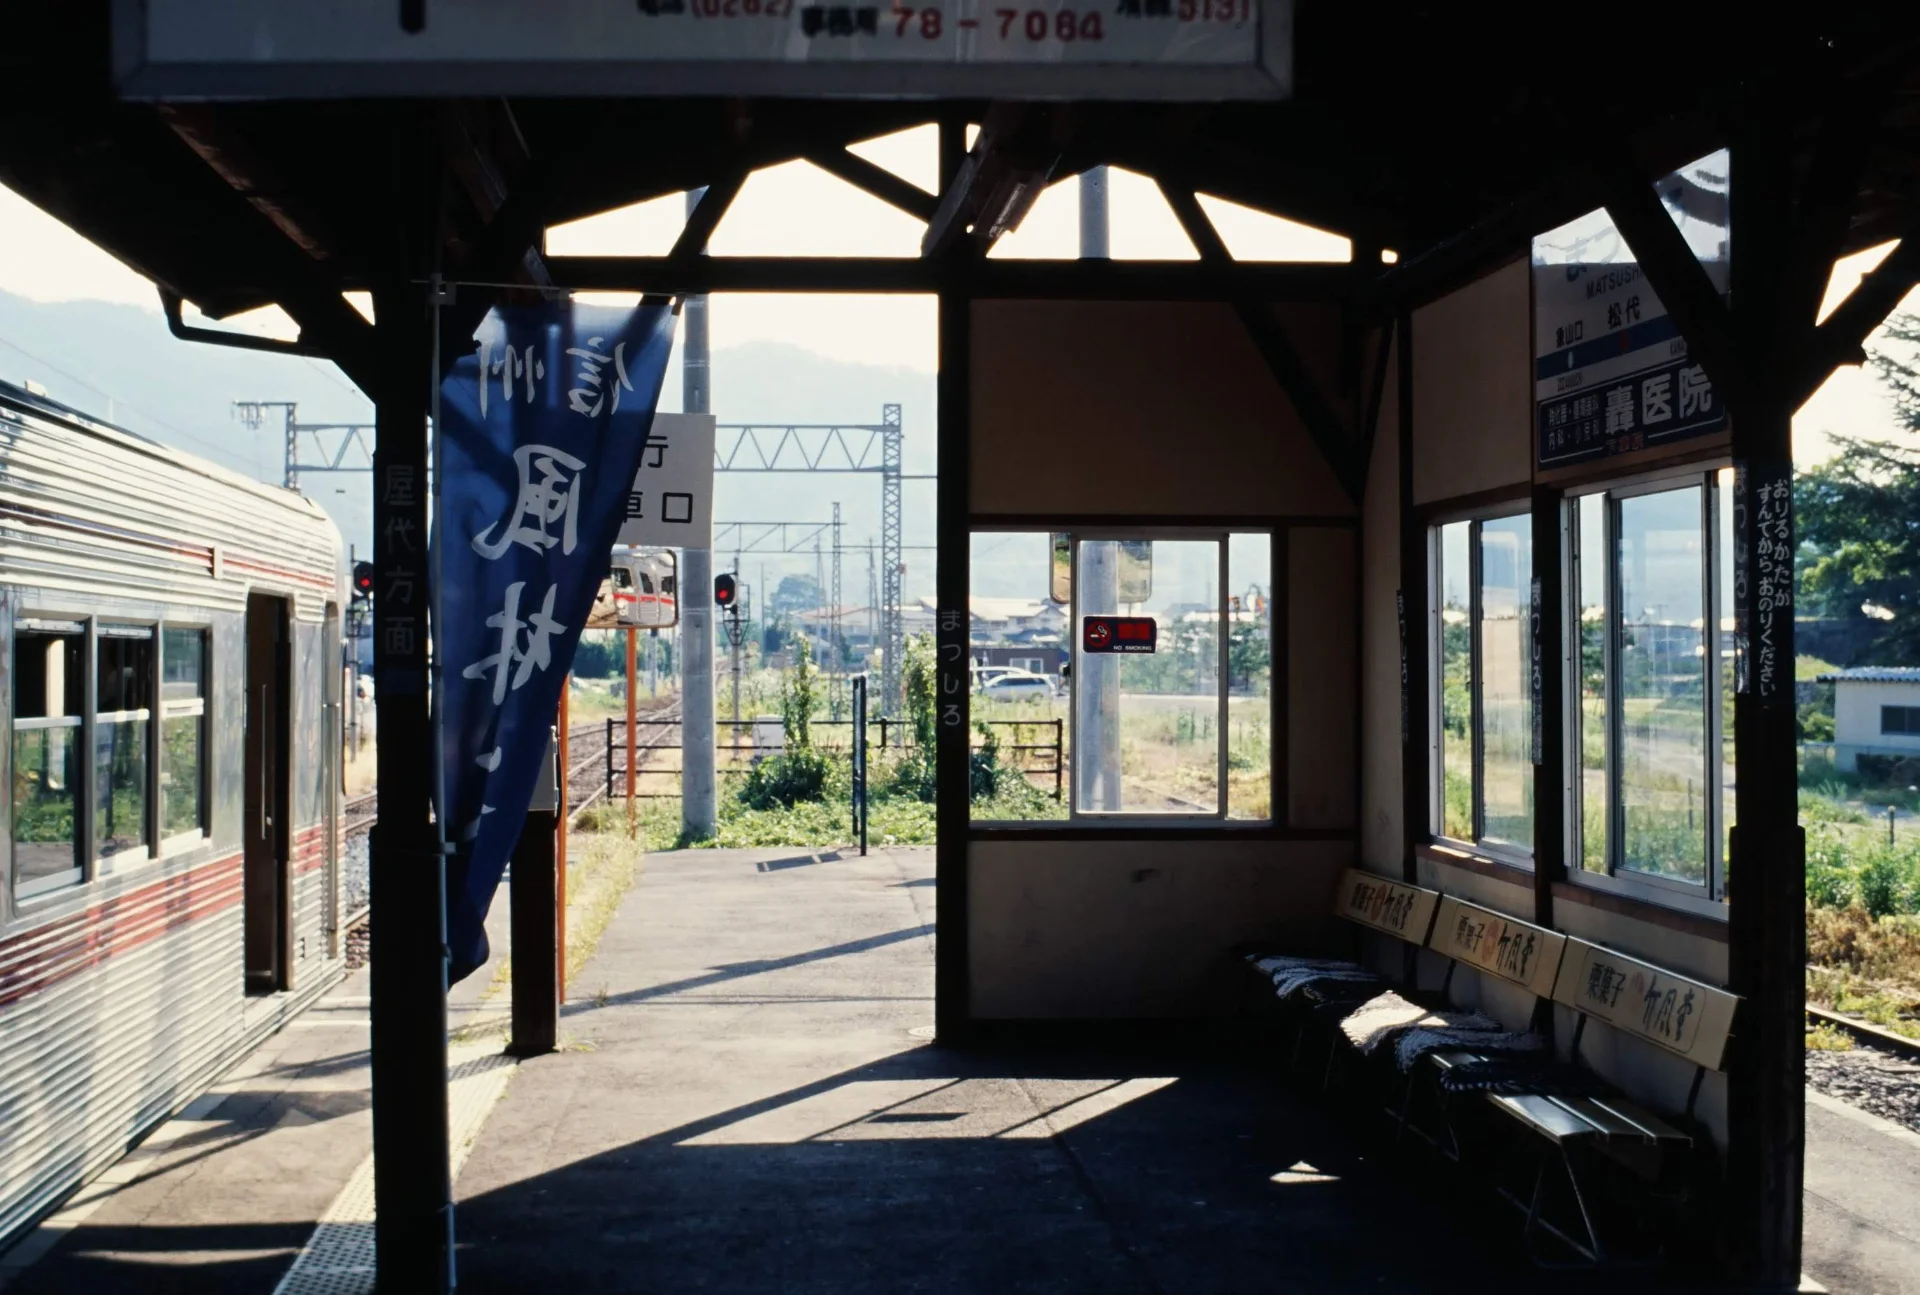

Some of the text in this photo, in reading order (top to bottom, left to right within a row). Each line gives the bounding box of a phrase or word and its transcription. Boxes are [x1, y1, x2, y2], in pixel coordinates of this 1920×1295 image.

[1608, 296, 1640, 329] 松代
[1604, 364, 1713, 436] 轟医院
[381, 464, 417, 657] 屋代方面
[1756, 482, 1776, 697] すんでからおのりください
[1773, 478, 1791, 608] おりるかたが
[940, 608, 962, 727] まつしろ
[1532, 581, 1542, 691] まつしろ
[1586, 962, 1627, 1009] 栗菓子
